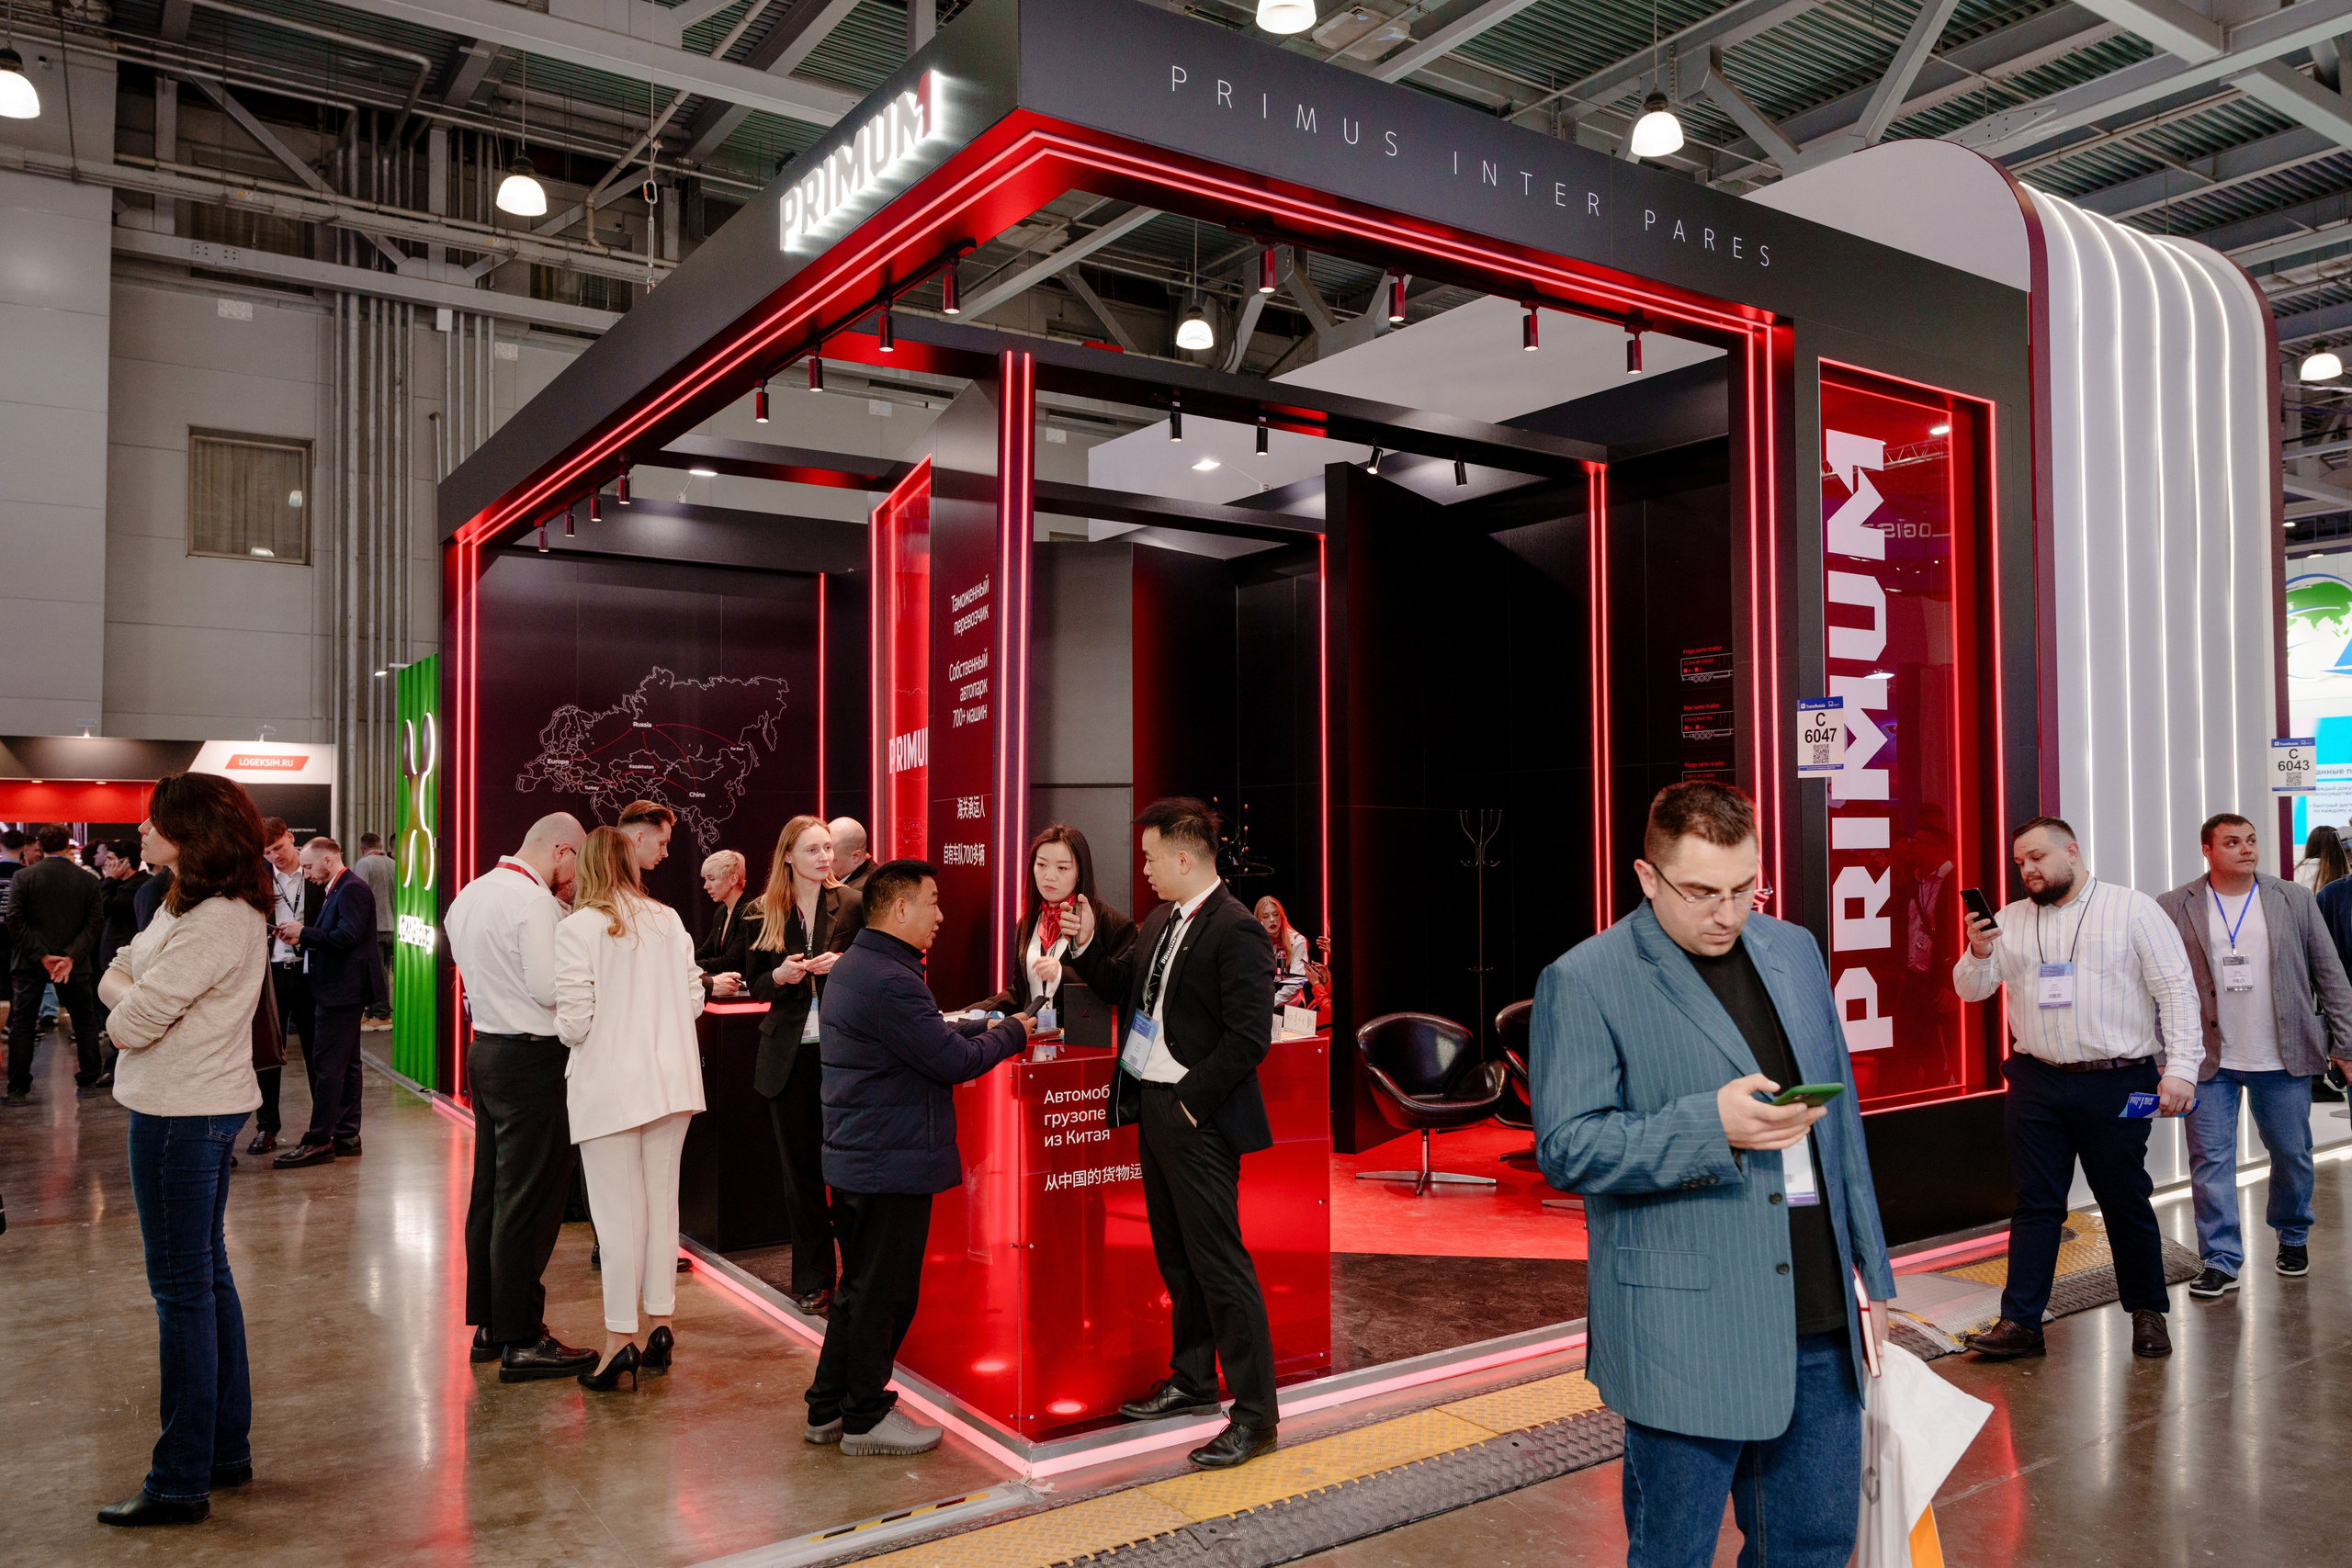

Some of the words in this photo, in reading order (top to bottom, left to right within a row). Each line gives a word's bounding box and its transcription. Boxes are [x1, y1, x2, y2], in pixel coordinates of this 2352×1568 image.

[779, 69, 937, 251] PRIMUM
[1171, 65, 1397, 157] PRIMUS
[1453, 151, 1600, 217] INTER
[1644, 209, 1770, 266] PARES
[951, 573, 989, 613] Таможенный
[954, 604, 989, 637] перевозчик
[949, 648, 989, 682] Собственный
[959, 678, 988, 702] автопарк
[953, 706, 966, 728] 700+
[966, 704, 988, 724] машин
[1815, 712, 1826, 727] C
[1804, 728, 1837, 743] 6047
[1826, 428, 1894, 1053] PRIMUM
[239, 758, 294, 767] LOGEKSIM.RU
[547, 758, 570, 766] Europe
[888, 727, 928, 774] PRIMU
[2289, 749, 2299, 759] C
[2278, 760, 2310, 772] 6043
[1045, 1134, 1063, 1147] из
[1066, 1129, 1110, 1145] Китая
